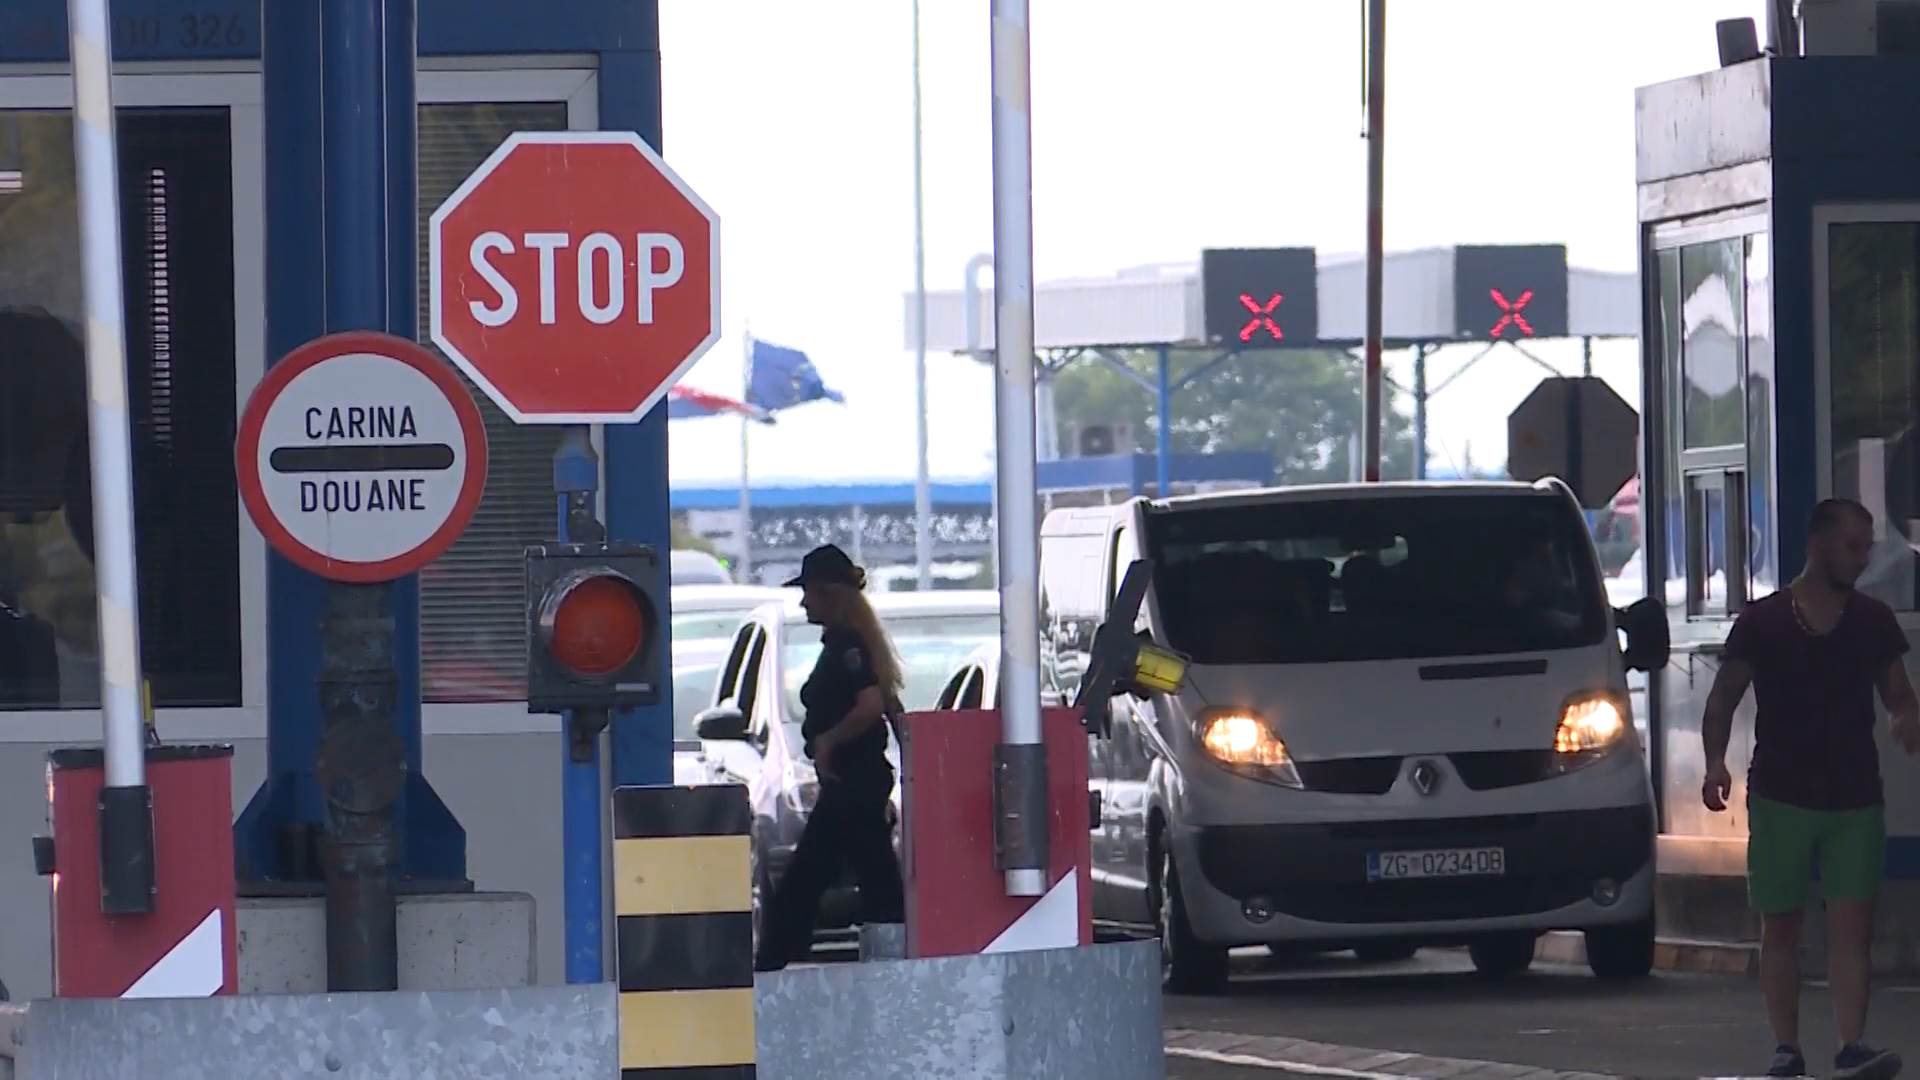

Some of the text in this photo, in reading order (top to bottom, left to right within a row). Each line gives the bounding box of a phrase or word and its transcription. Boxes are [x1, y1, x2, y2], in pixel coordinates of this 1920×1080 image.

[178, 14, 247, 49] 326
[468, 231, 685, 326] STOP
[305, 405, 418, 440] CARINA
[300, 478, 426, 515] DOUANE
[1382, 854, 1409, 877] ZG
